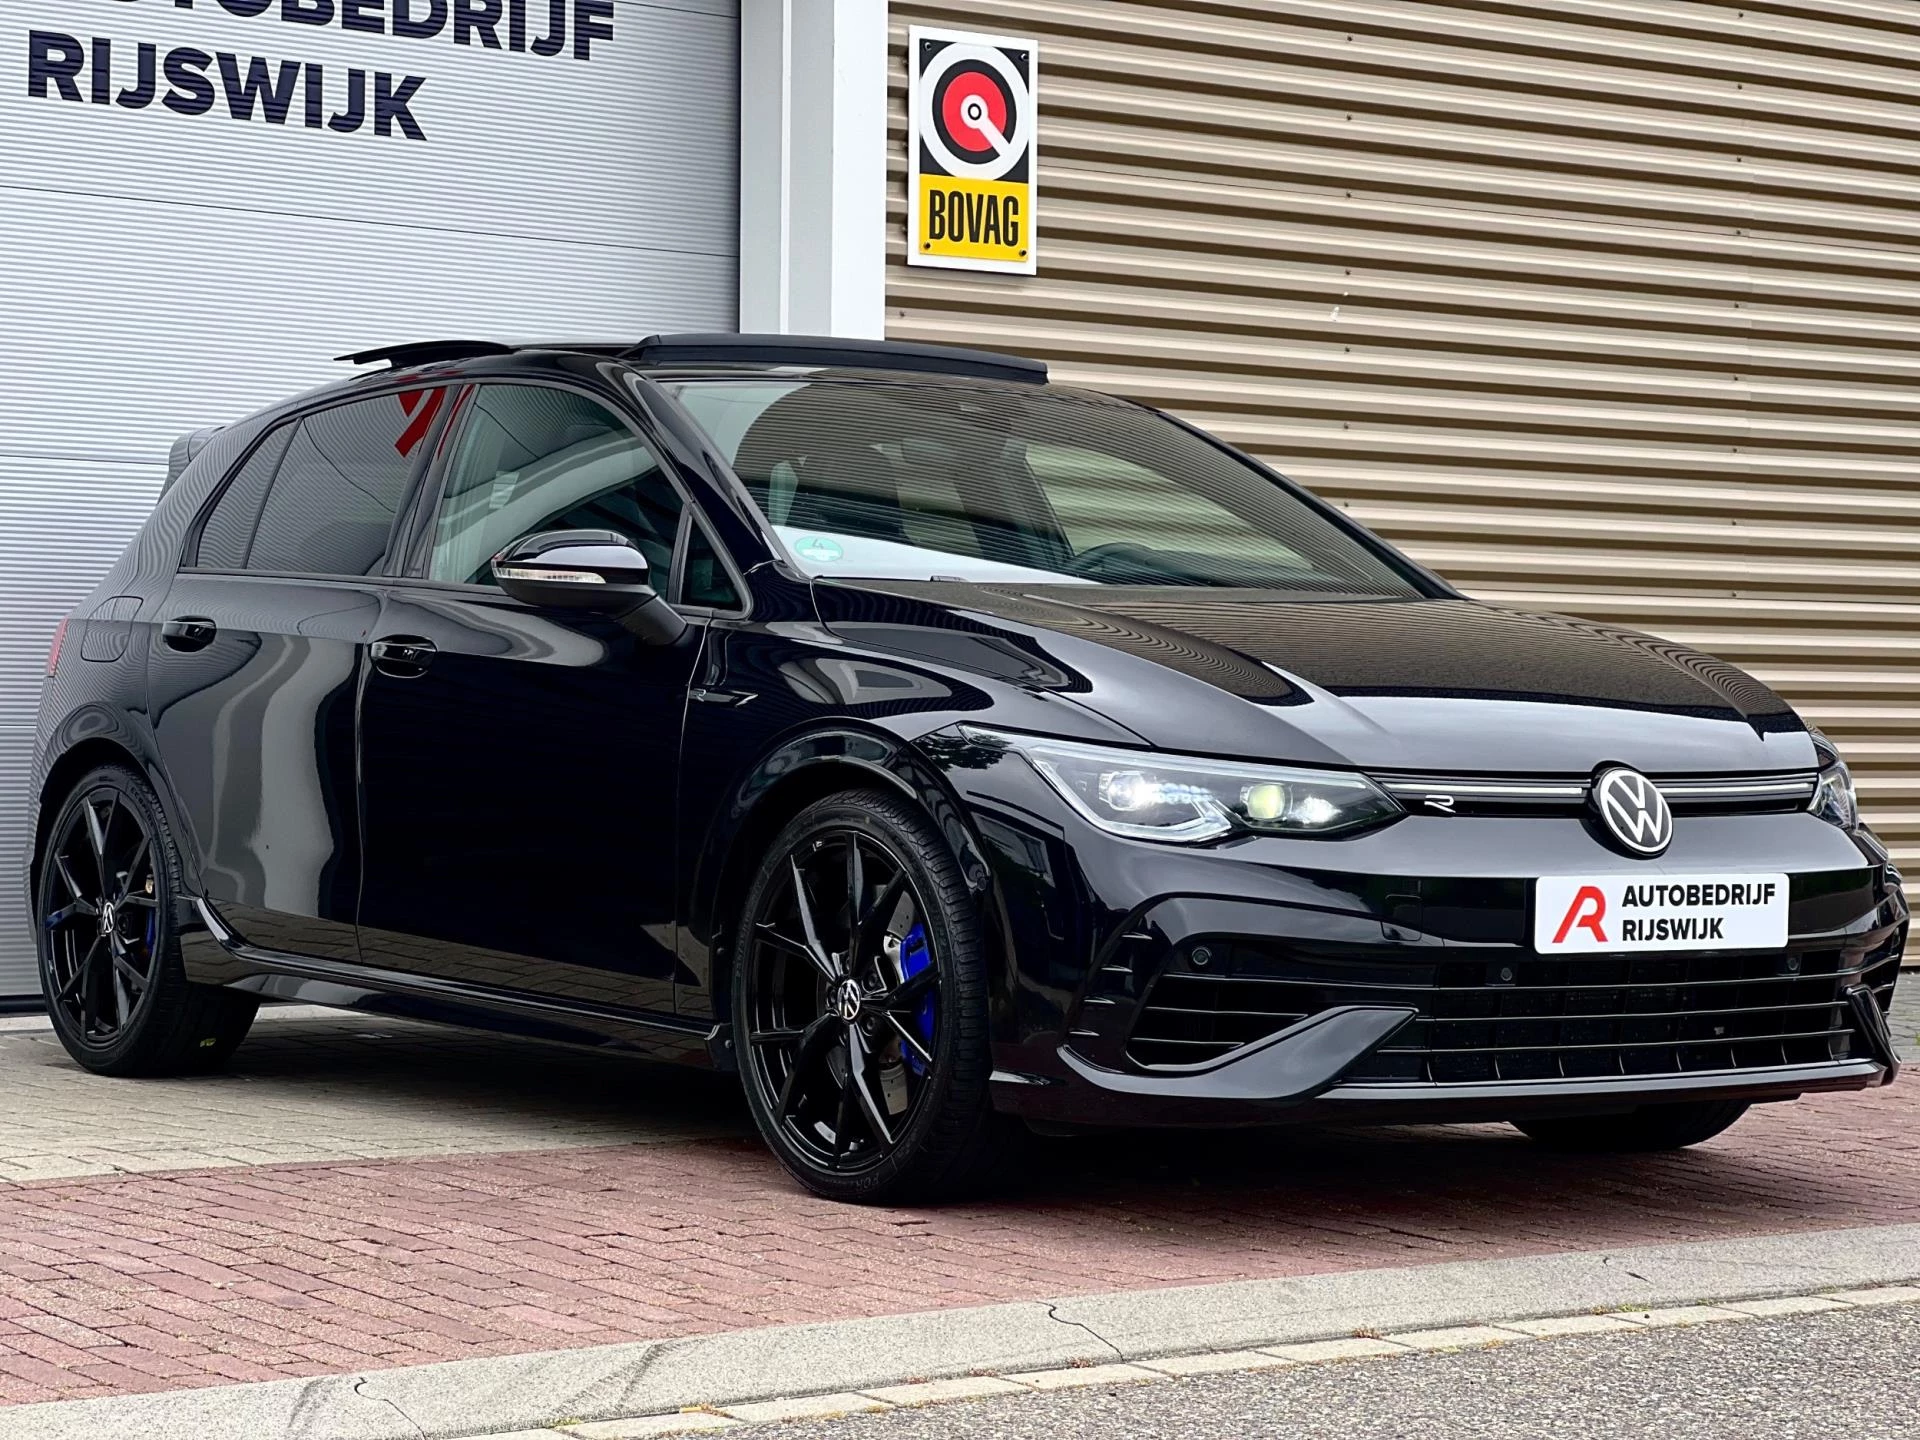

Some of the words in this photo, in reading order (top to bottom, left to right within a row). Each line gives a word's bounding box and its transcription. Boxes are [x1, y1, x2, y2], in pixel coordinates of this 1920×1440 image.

[112, 0, 614, 60] EDRIJF
[27, 30, 427, 141] RIJSWIJK
[929, 189, 1019, 247] BOVAG
[1621, 883, 1776, 907] AUTOBEDRIJF
[1621, 917, 1724, 941] RIJSWIJK
